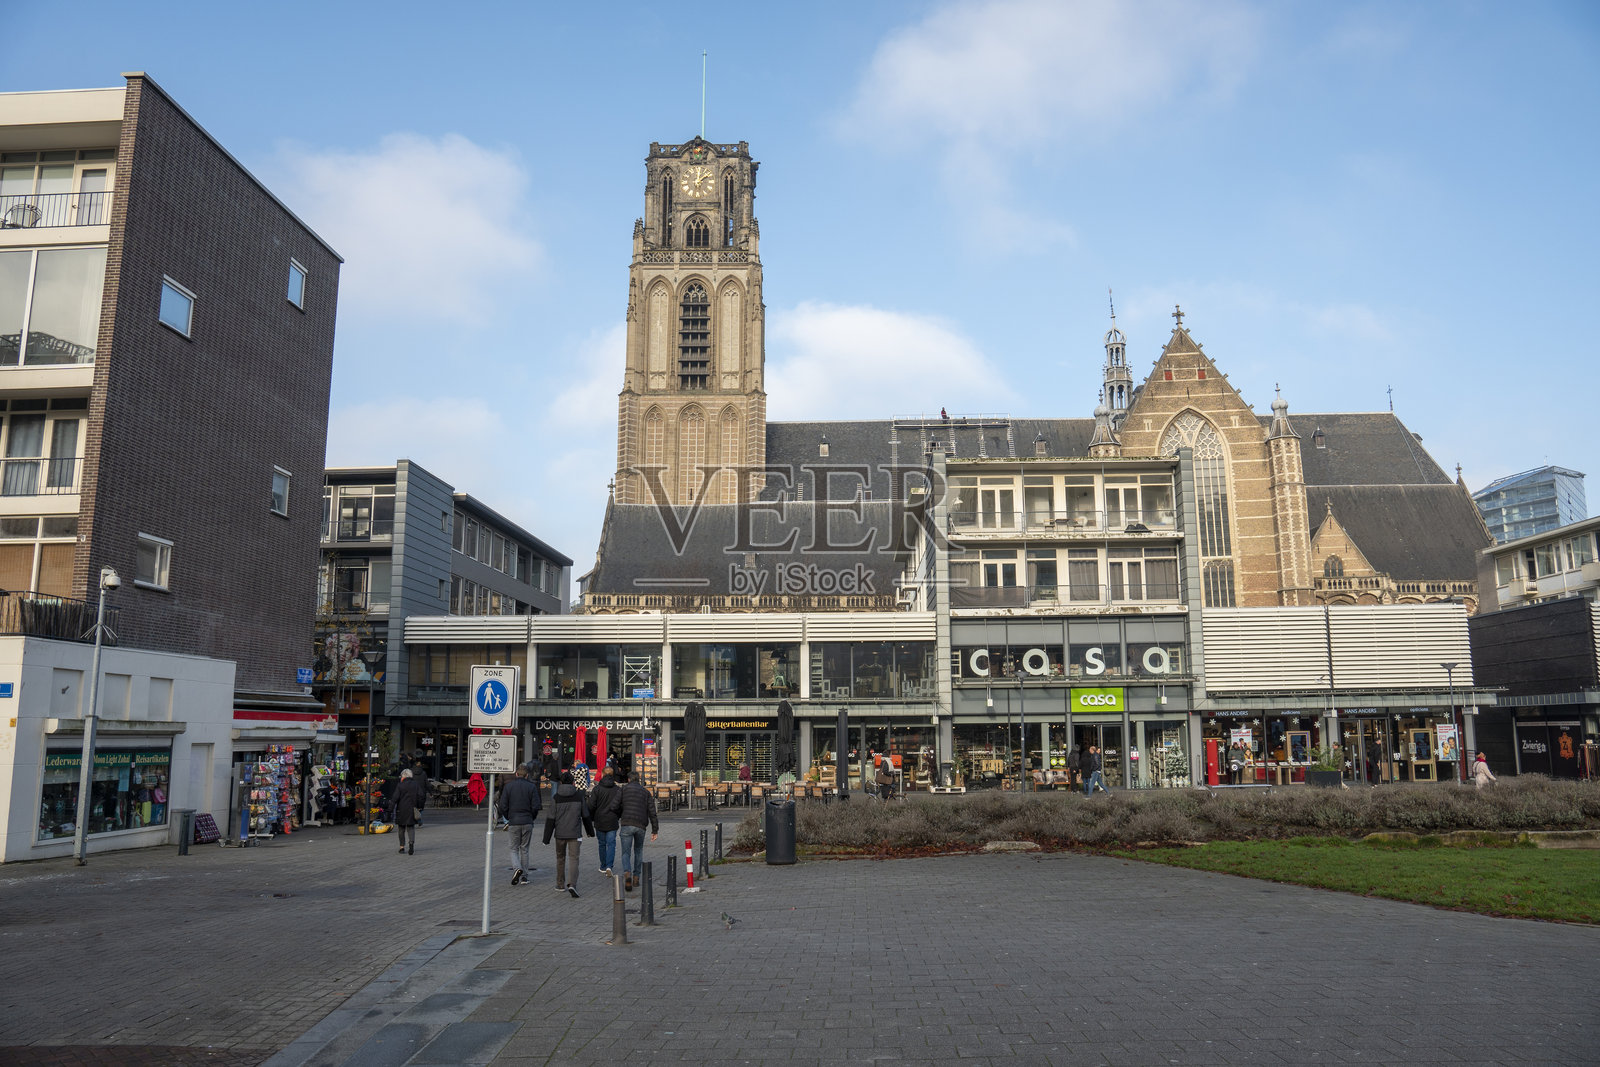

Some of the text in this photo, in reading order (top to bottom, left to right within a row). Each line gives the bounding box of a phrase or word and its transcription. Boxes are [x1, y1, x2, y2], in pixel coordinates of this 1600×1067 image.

[970, 646, 1171, 676] casa
[484, 669, 503, 677] ZONE
[1079, 694, 1117, 707] casa
[536, 719, 570, 730] DÖNER
[606, 720, 613, 730] &
[46, 756, 83, 766] Lederware
